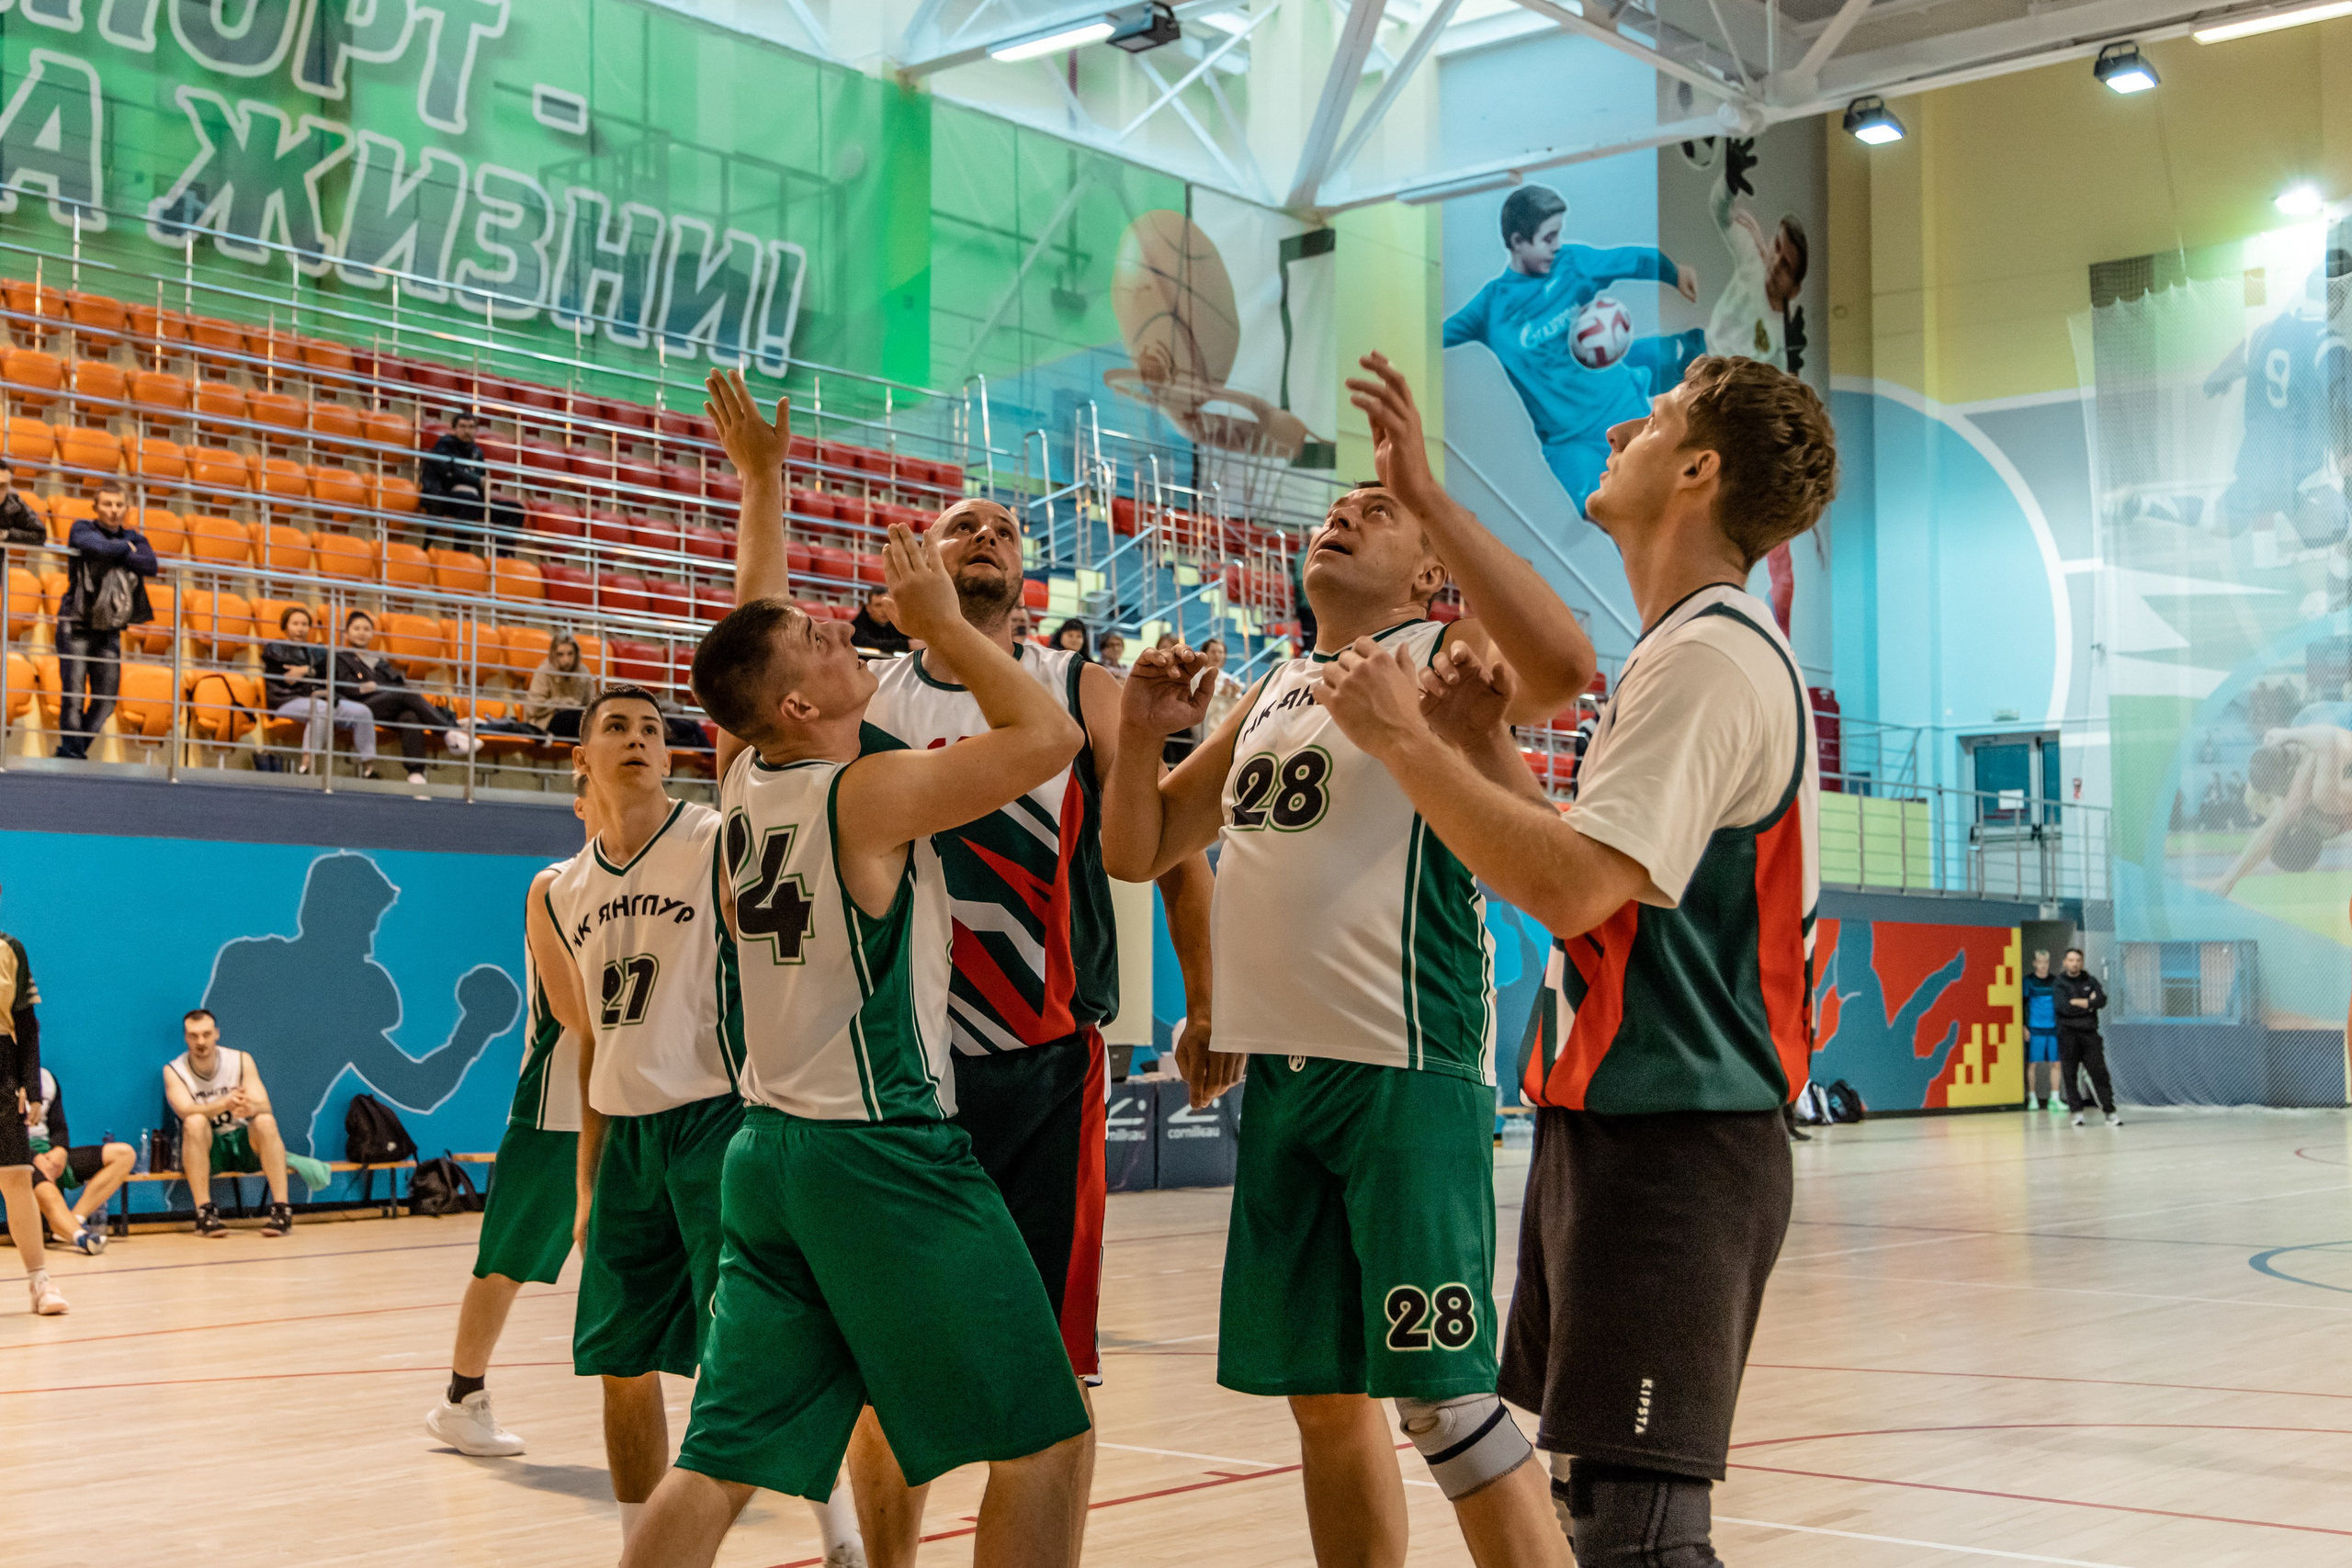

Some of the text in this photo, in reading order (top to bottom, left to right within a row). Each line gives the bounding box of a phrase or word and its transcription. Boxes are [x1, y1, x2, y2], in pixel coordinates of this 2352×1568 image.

[147, 85, 807, 378] ЖИЗНИ!
[2266, 349, 2290, 409] 9
[1227, 744, 1332, 833] 28
[598, 894, 695, 926] ЯНГПУР
[1385, 1282, 1477, 1352] 28
[1634, 1378, 1653, 1434] KIPSTA
